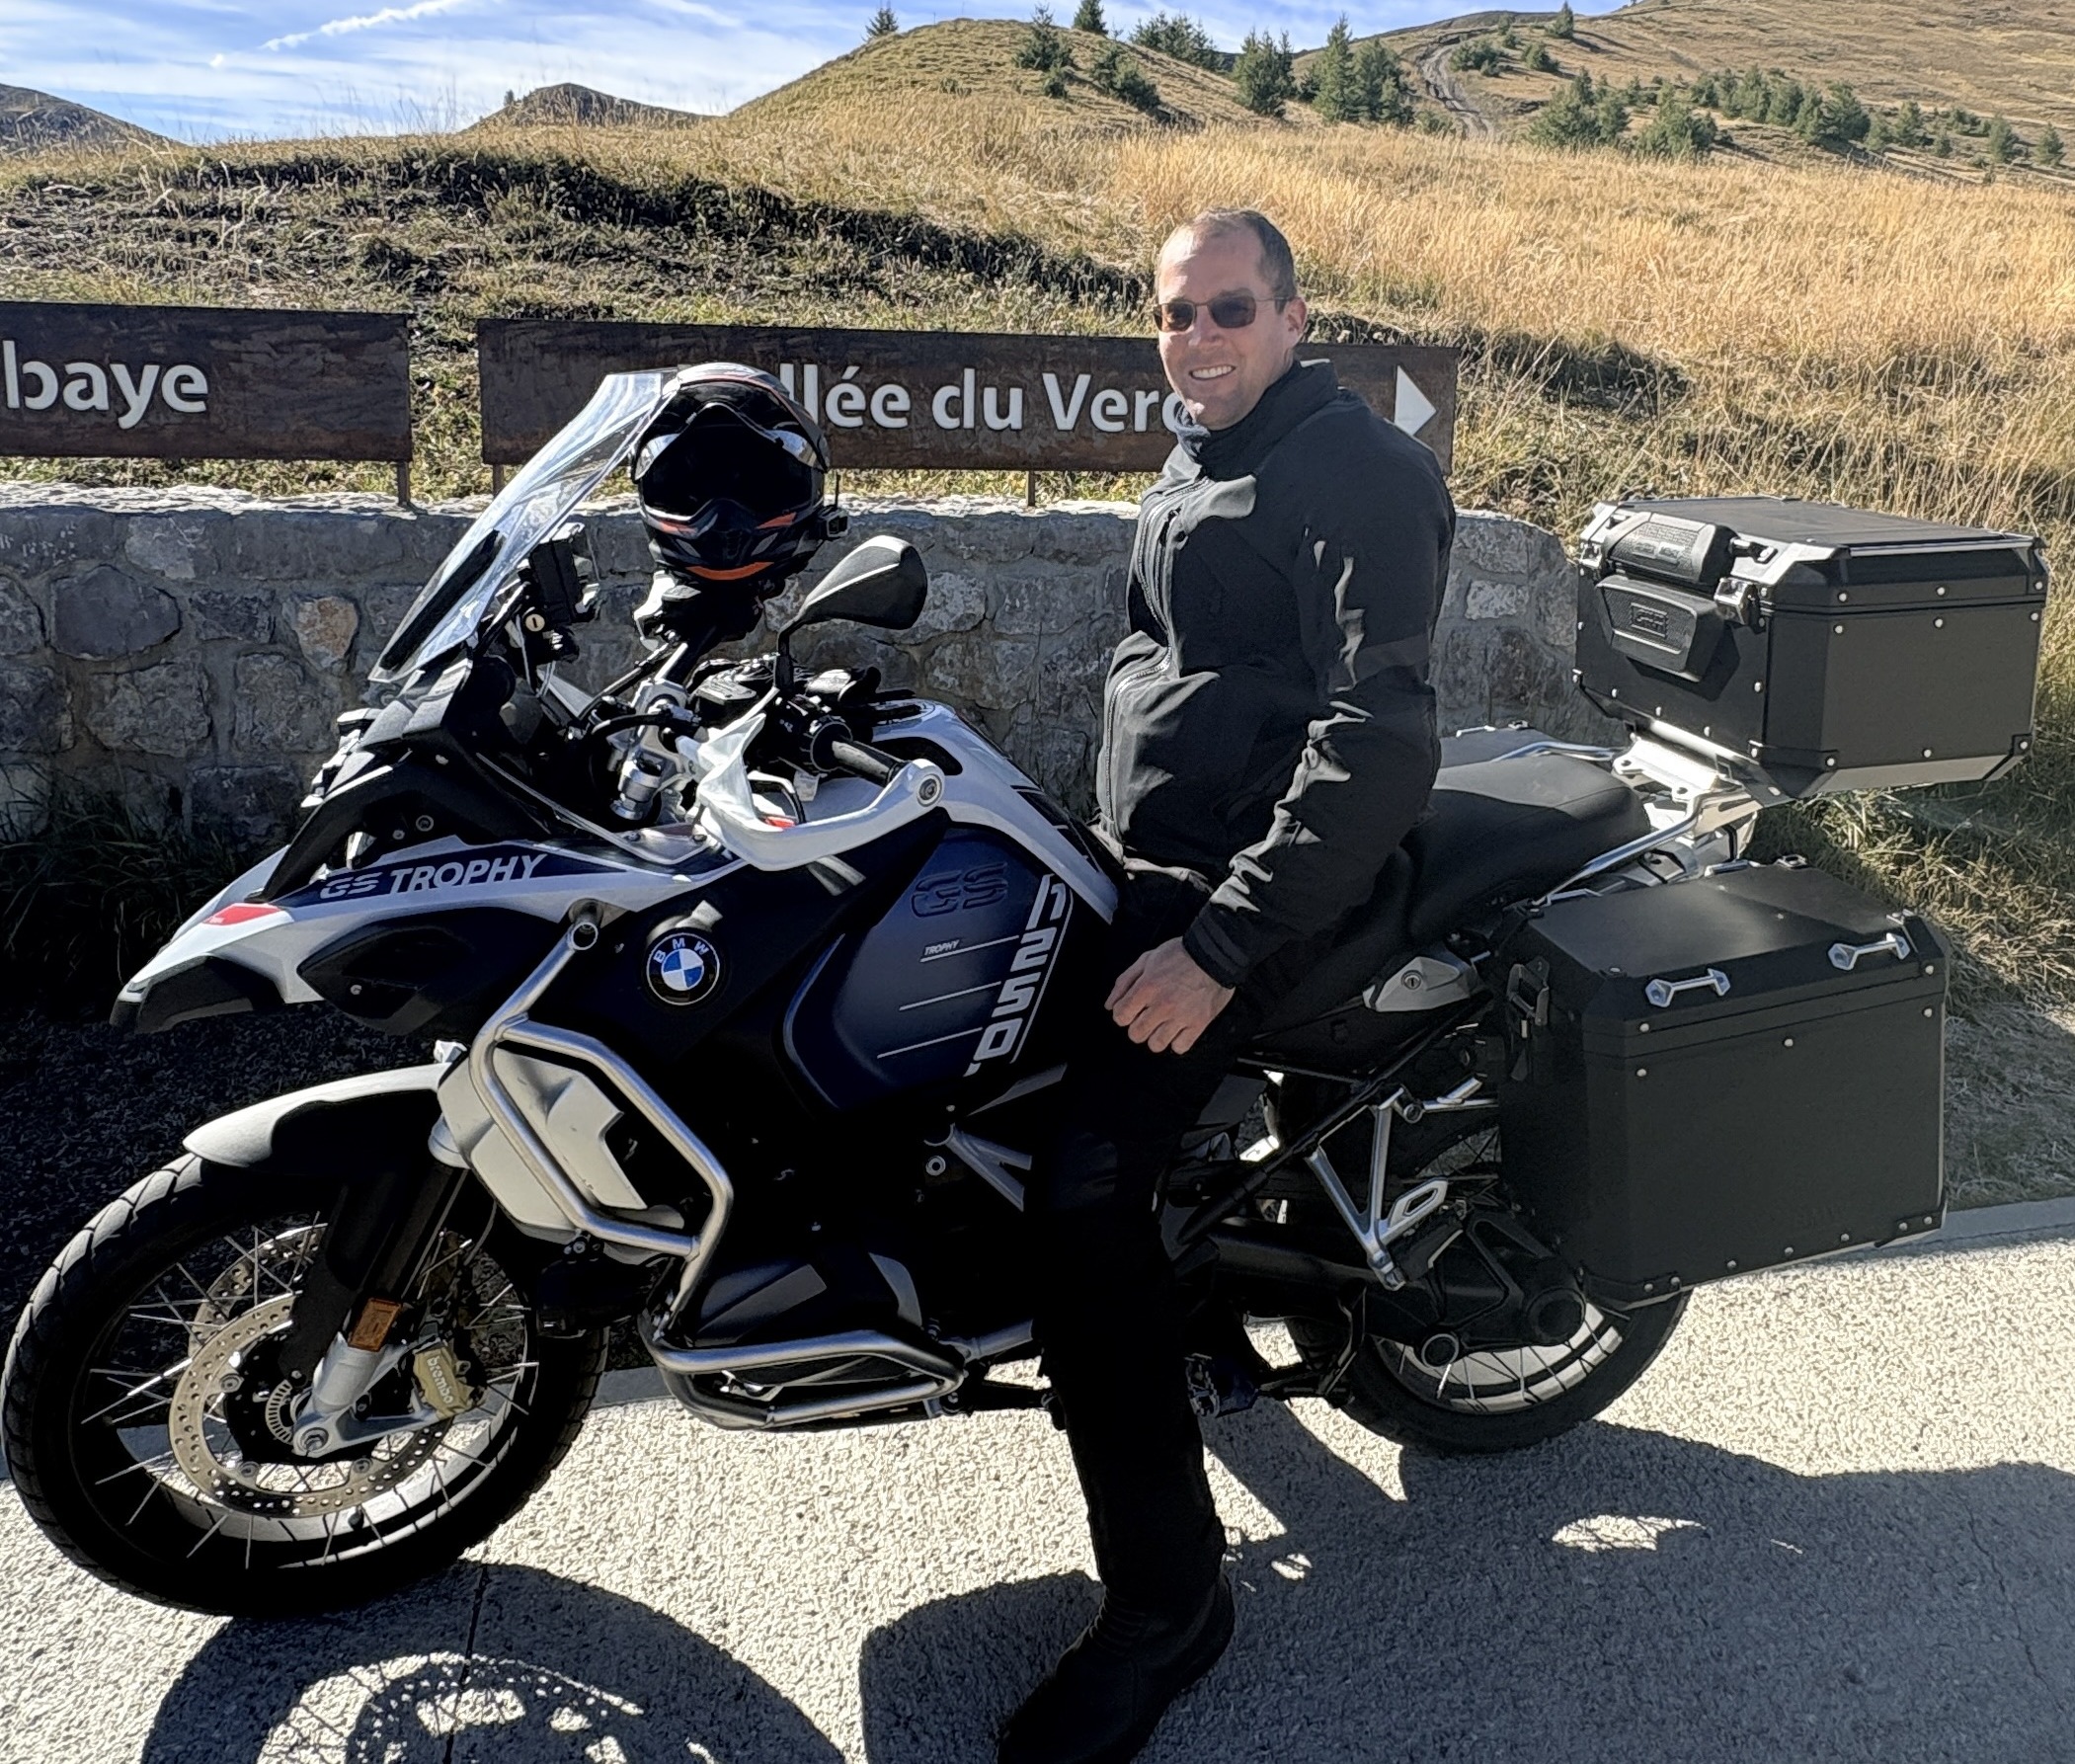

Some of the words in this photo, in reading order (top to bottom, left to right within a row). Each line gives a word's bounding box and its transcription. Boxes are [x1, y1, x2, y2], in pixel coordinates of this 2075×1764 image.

[931, 367, 1023, 431] du
[320, 871, 383, 900] GS
[388, 853, 548, 895] TROPHY
[911, 861, 1008, 919] GS
[653, 937, 709, 964] BMW
[923, 938, 961, 956] TROPHY
[427, 1355, 454, 1404] brembo
